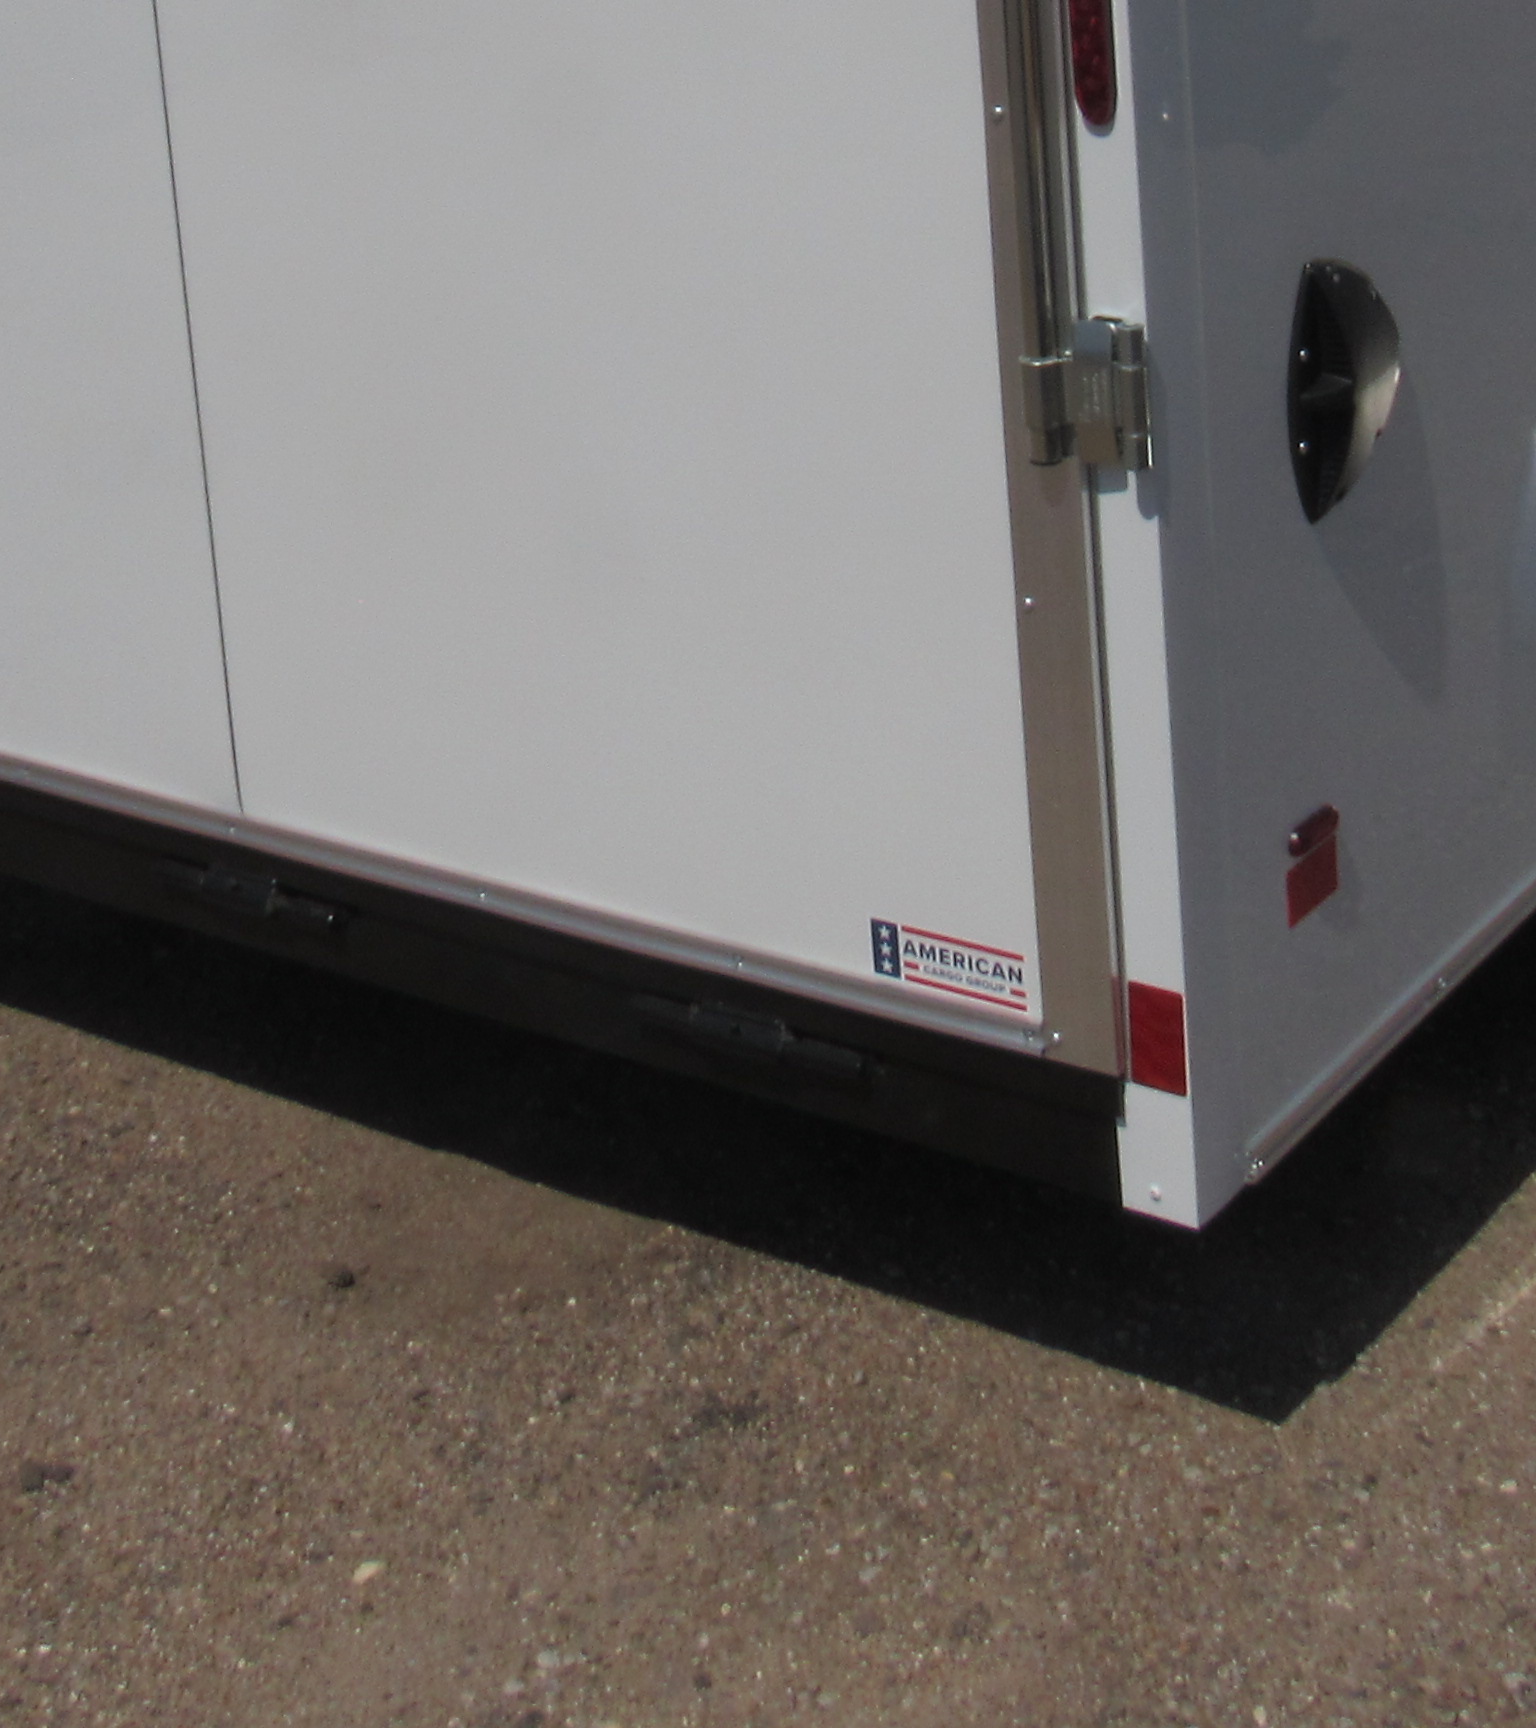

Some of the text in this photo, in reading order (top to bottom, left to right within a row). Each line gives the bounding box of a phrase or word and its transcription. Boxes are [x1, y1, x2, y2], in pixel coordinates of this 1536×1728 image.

[902, 939, 1024, 984] AMERICAN
[923, 964, 1006, 992] CARGO GROUP
